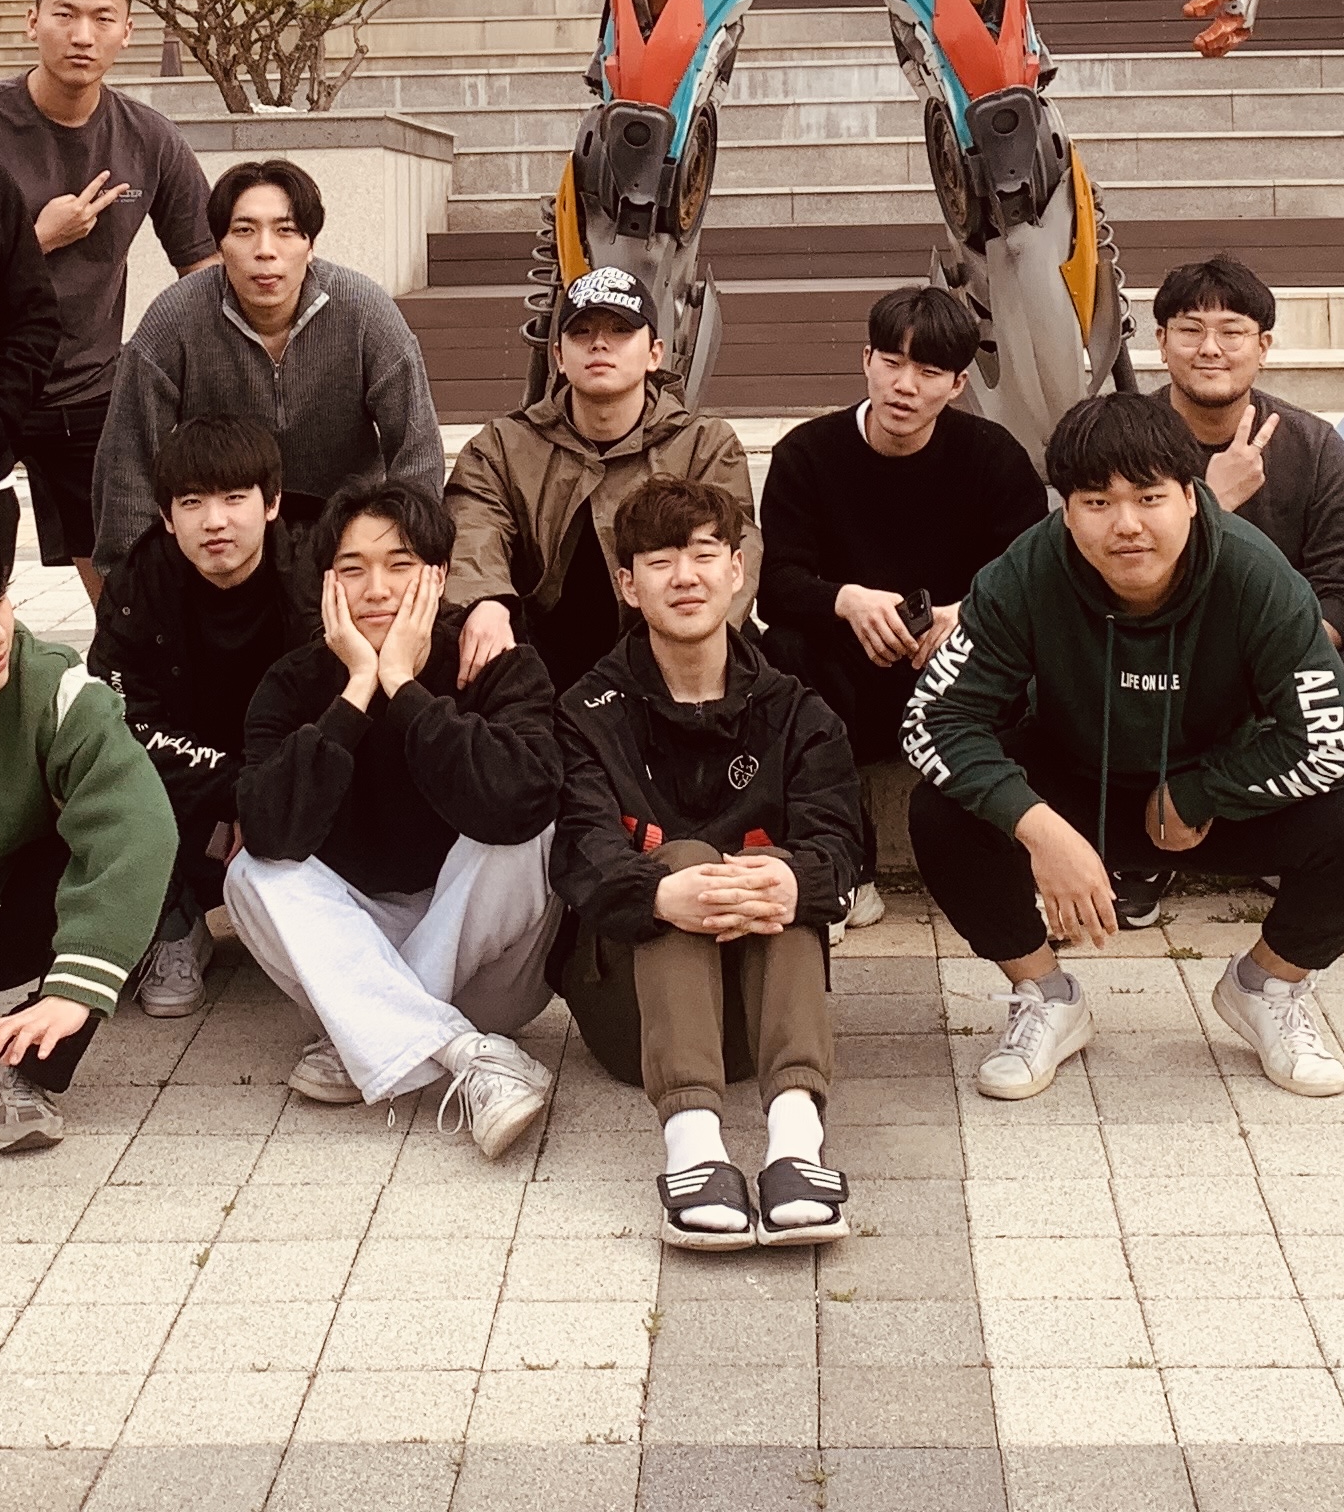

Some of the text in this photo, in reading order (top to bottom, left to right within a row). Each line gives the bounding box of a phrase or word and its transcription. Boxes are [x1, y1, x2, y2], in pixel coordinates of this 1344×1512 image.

[573, 289, 643, 313] Pound
[924, 624, 975, 697] LIKE
[1120, 671, 1181, 691] LIFE ON LIE
